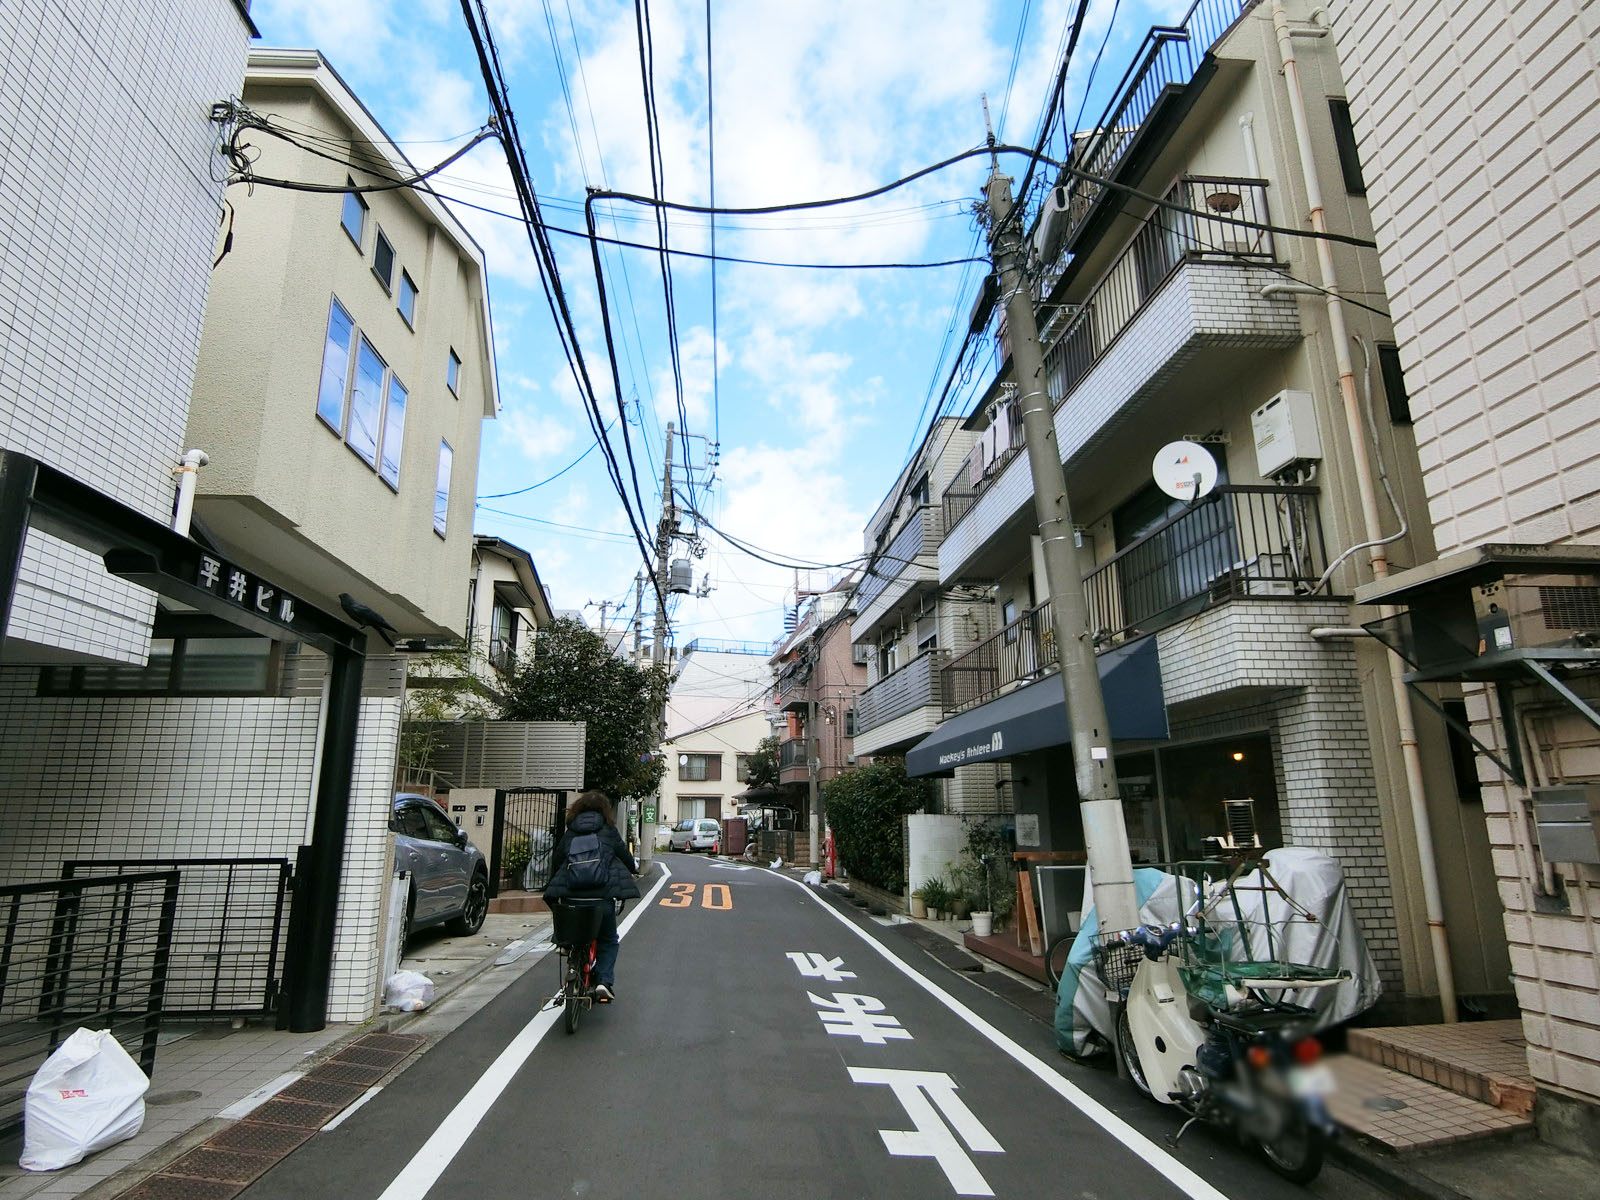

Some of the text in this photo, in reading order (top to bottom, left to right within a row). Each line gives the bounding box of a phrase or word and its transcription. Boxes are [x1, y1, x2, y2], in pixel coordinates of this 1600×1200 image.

[200, 555, 295, 623] 平井ビル
[939, 743, 991, 765] Mackey's Athlete
[658, 882, 733, 910] 30
[785, 952, 1006, 1196] 止まれ
